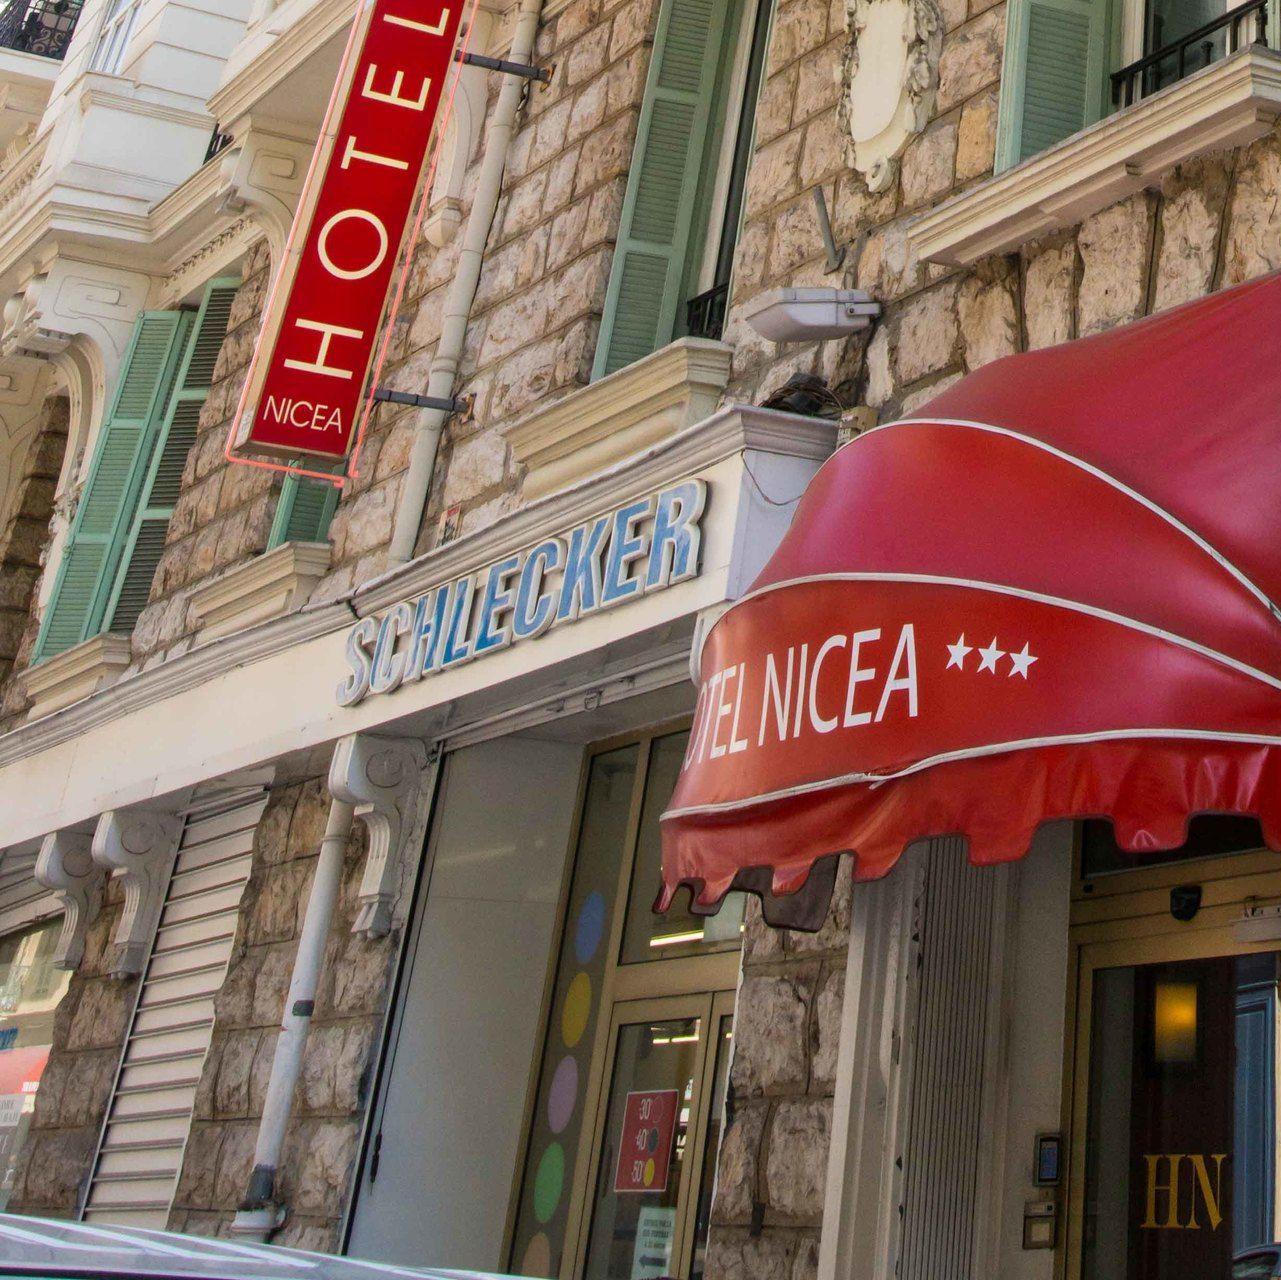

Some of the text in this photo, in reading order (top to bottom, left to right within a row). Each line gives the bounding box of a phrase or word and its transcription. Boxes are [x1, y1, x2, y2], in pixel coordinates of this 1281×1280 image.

[283, 7, 451, 380] HOTEL
[262, 394, 343, 435] NICEA
[335, 477, 708, 708] SCHLECKER
[680, 622, 919, 773] OTEL NICEA
[1139, 1152, 1229, 1232] HN
